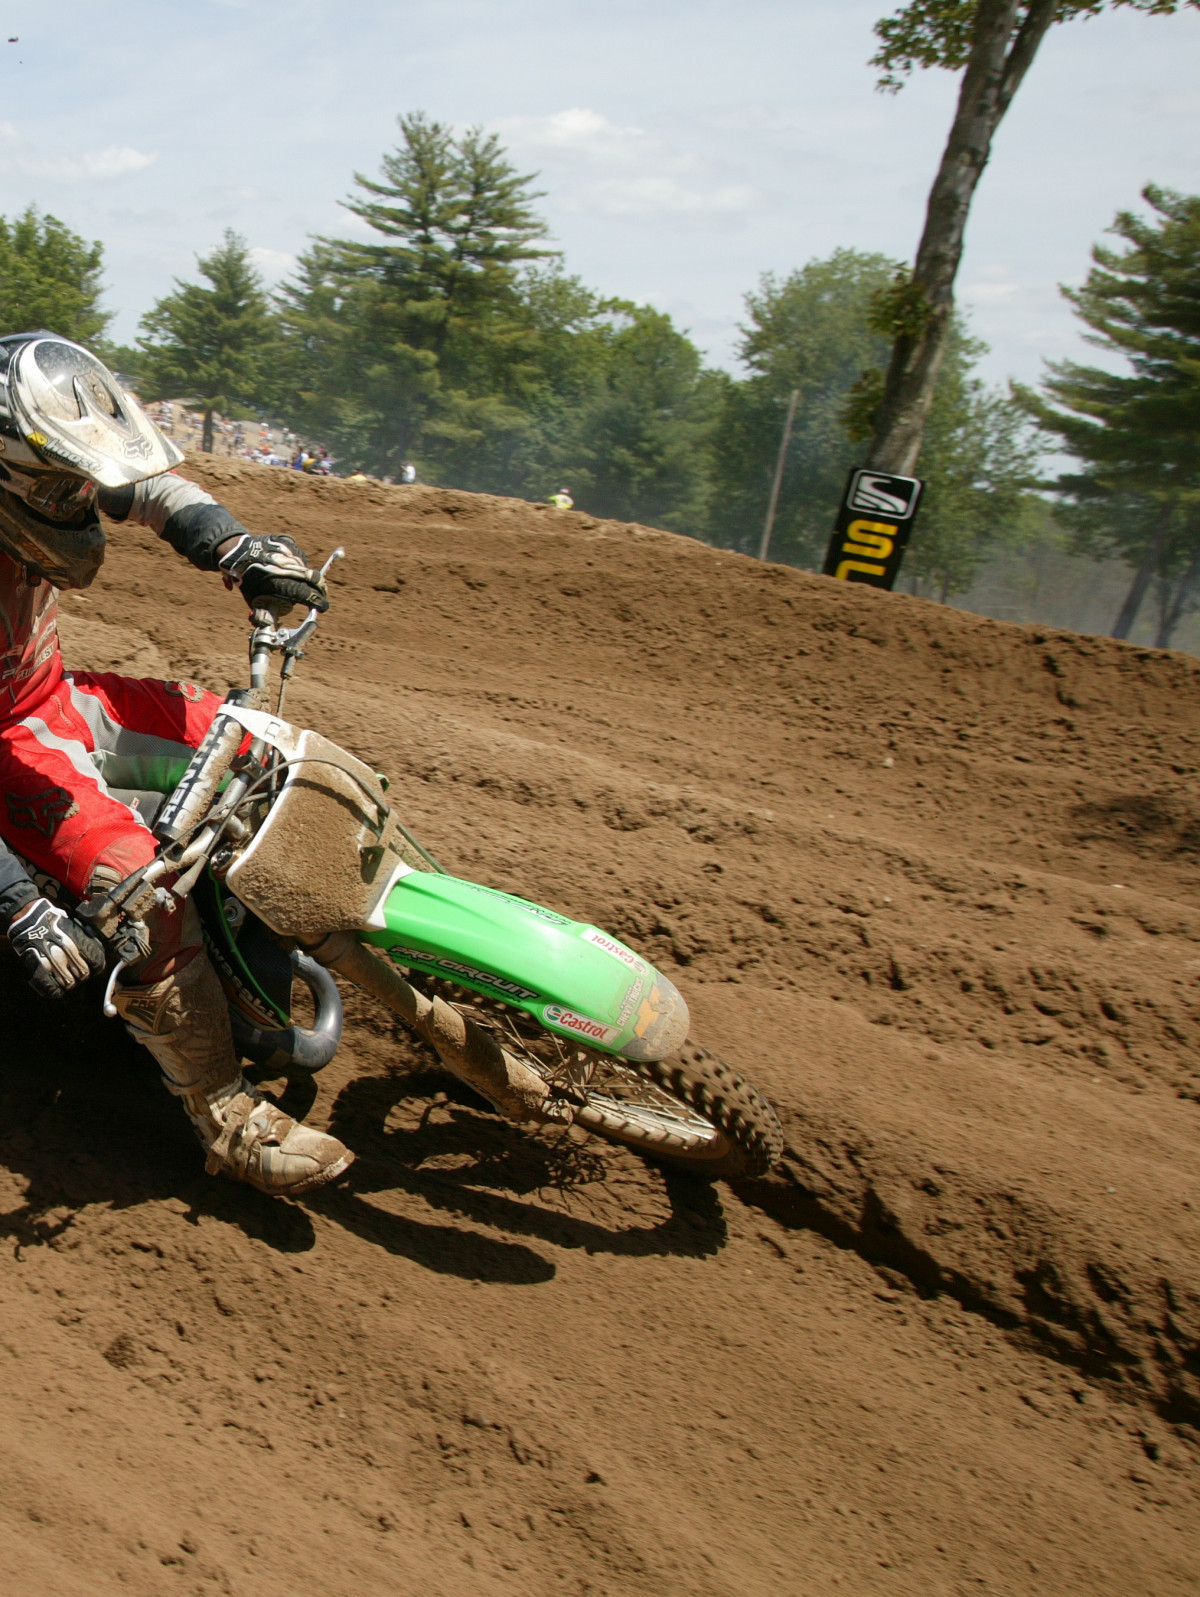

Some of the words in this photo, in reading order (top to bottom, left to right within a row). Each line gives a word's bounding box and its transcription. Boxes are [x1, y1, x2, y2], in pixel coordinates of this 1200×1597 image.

[158, 699, 234, 824] RENTHA
[389, 945, 436, 961] PRO
[437, 958, 540, 999] CIRCUIT
[591, 934, 635, 964] Castrol
[560, 1012, 609, 1039] Castrol
[616, 1001, 634, 1027] CHEVY
[628, 976, 644, 1003] TRUCKS
